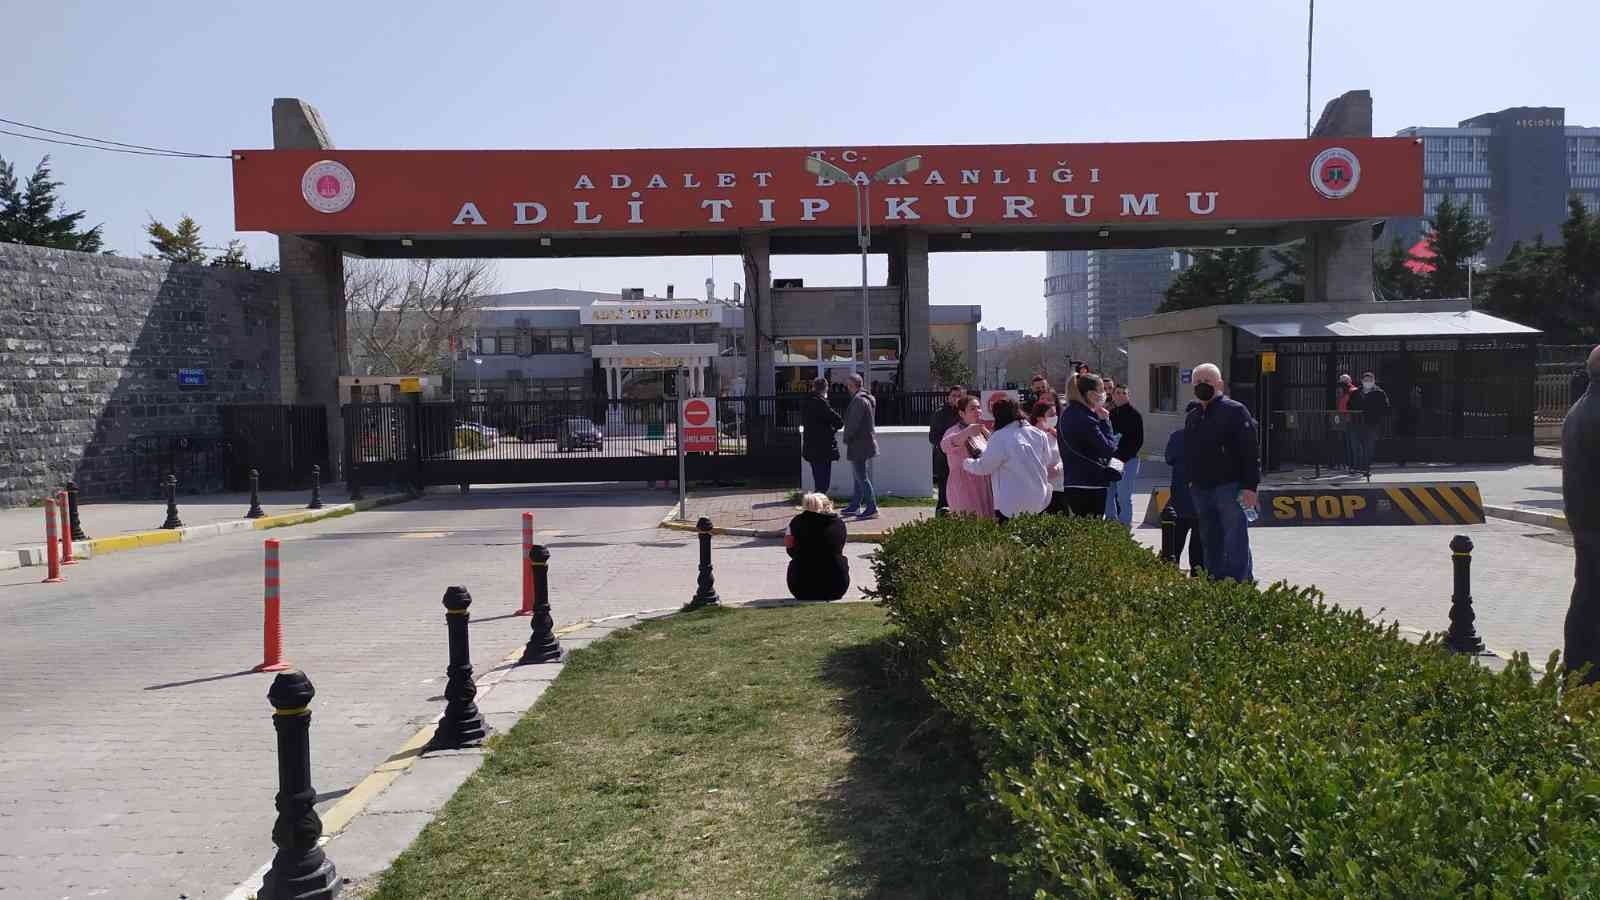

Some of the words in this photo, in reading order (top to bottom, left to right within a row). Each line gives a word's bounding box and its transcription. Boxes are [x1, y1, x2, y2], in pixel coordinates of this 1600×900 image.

[575, 172, 772, 189] ADALET
[452, 190, 645, 226] ADLİ
[701, 197, 831, 223] TIP
[884, 190, 1220, 221] KURUMU
[1272, 495, 1367, 520] STOP
